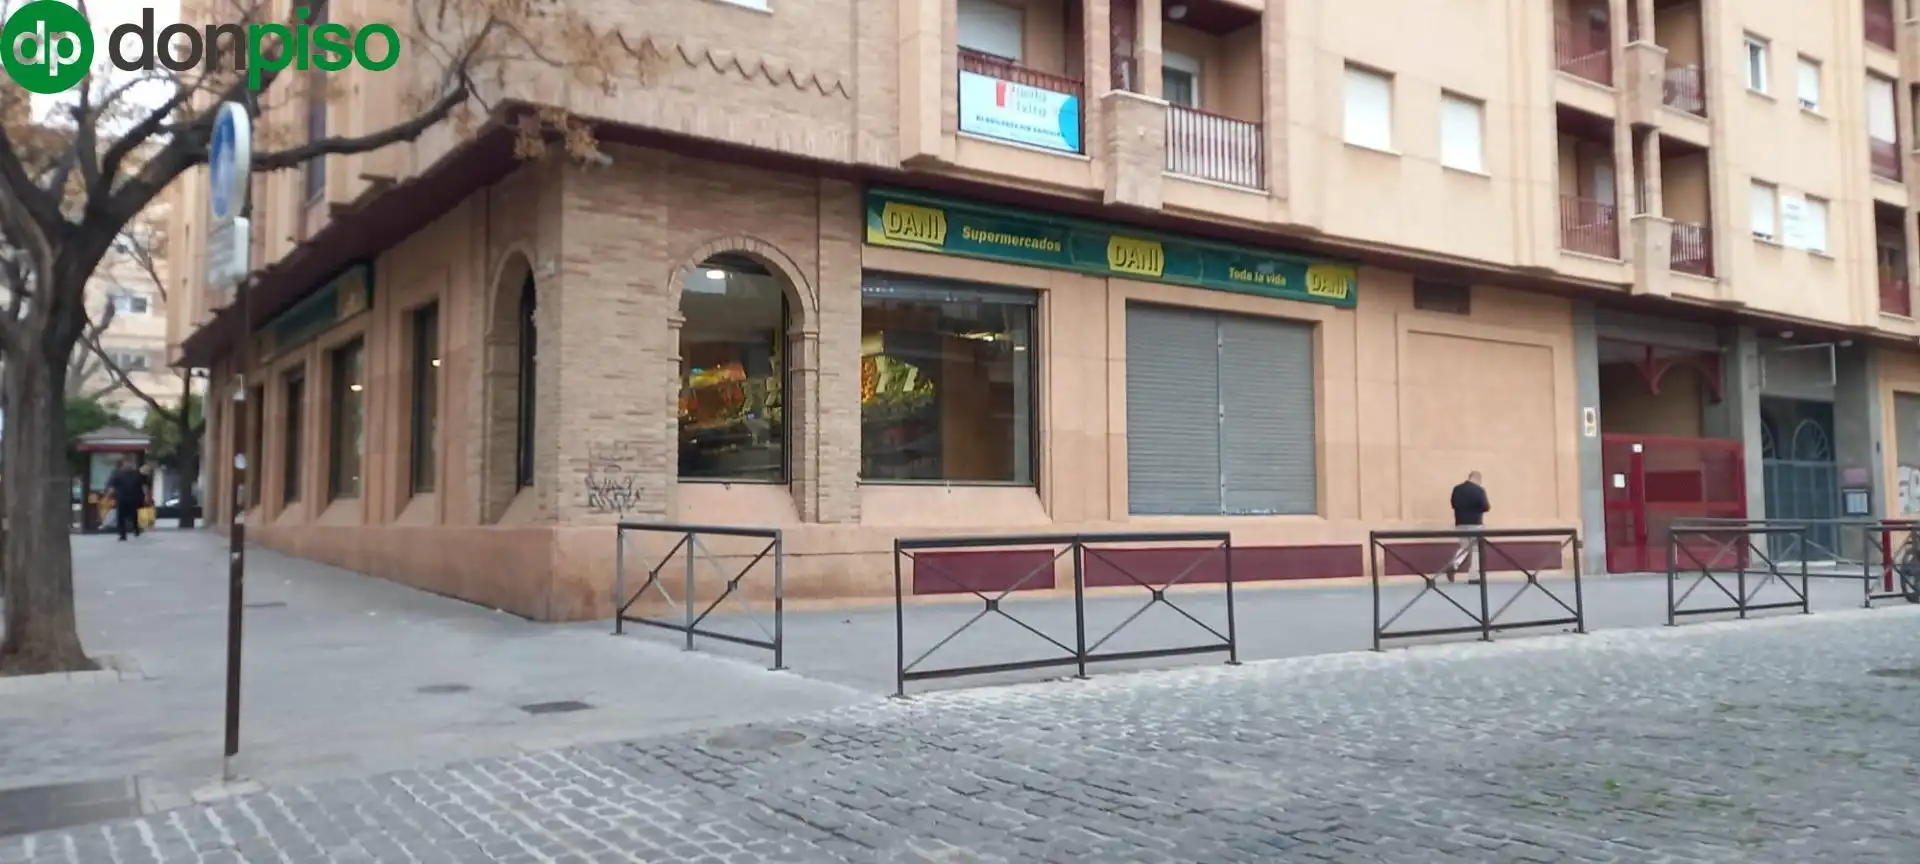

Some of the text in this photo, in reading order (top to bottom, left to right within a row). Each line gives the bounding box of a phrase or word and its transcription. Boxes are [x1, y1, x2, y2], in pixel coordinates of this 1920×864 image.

[888, 210, 940, 240] DANI
[962, 225, 1061, 252] Supermercados
[1115, 245, 1161, 273] DANI
[1229, 266, 1286, 287] Toda la vida
[1311, 273, 1348, 296] DANI
